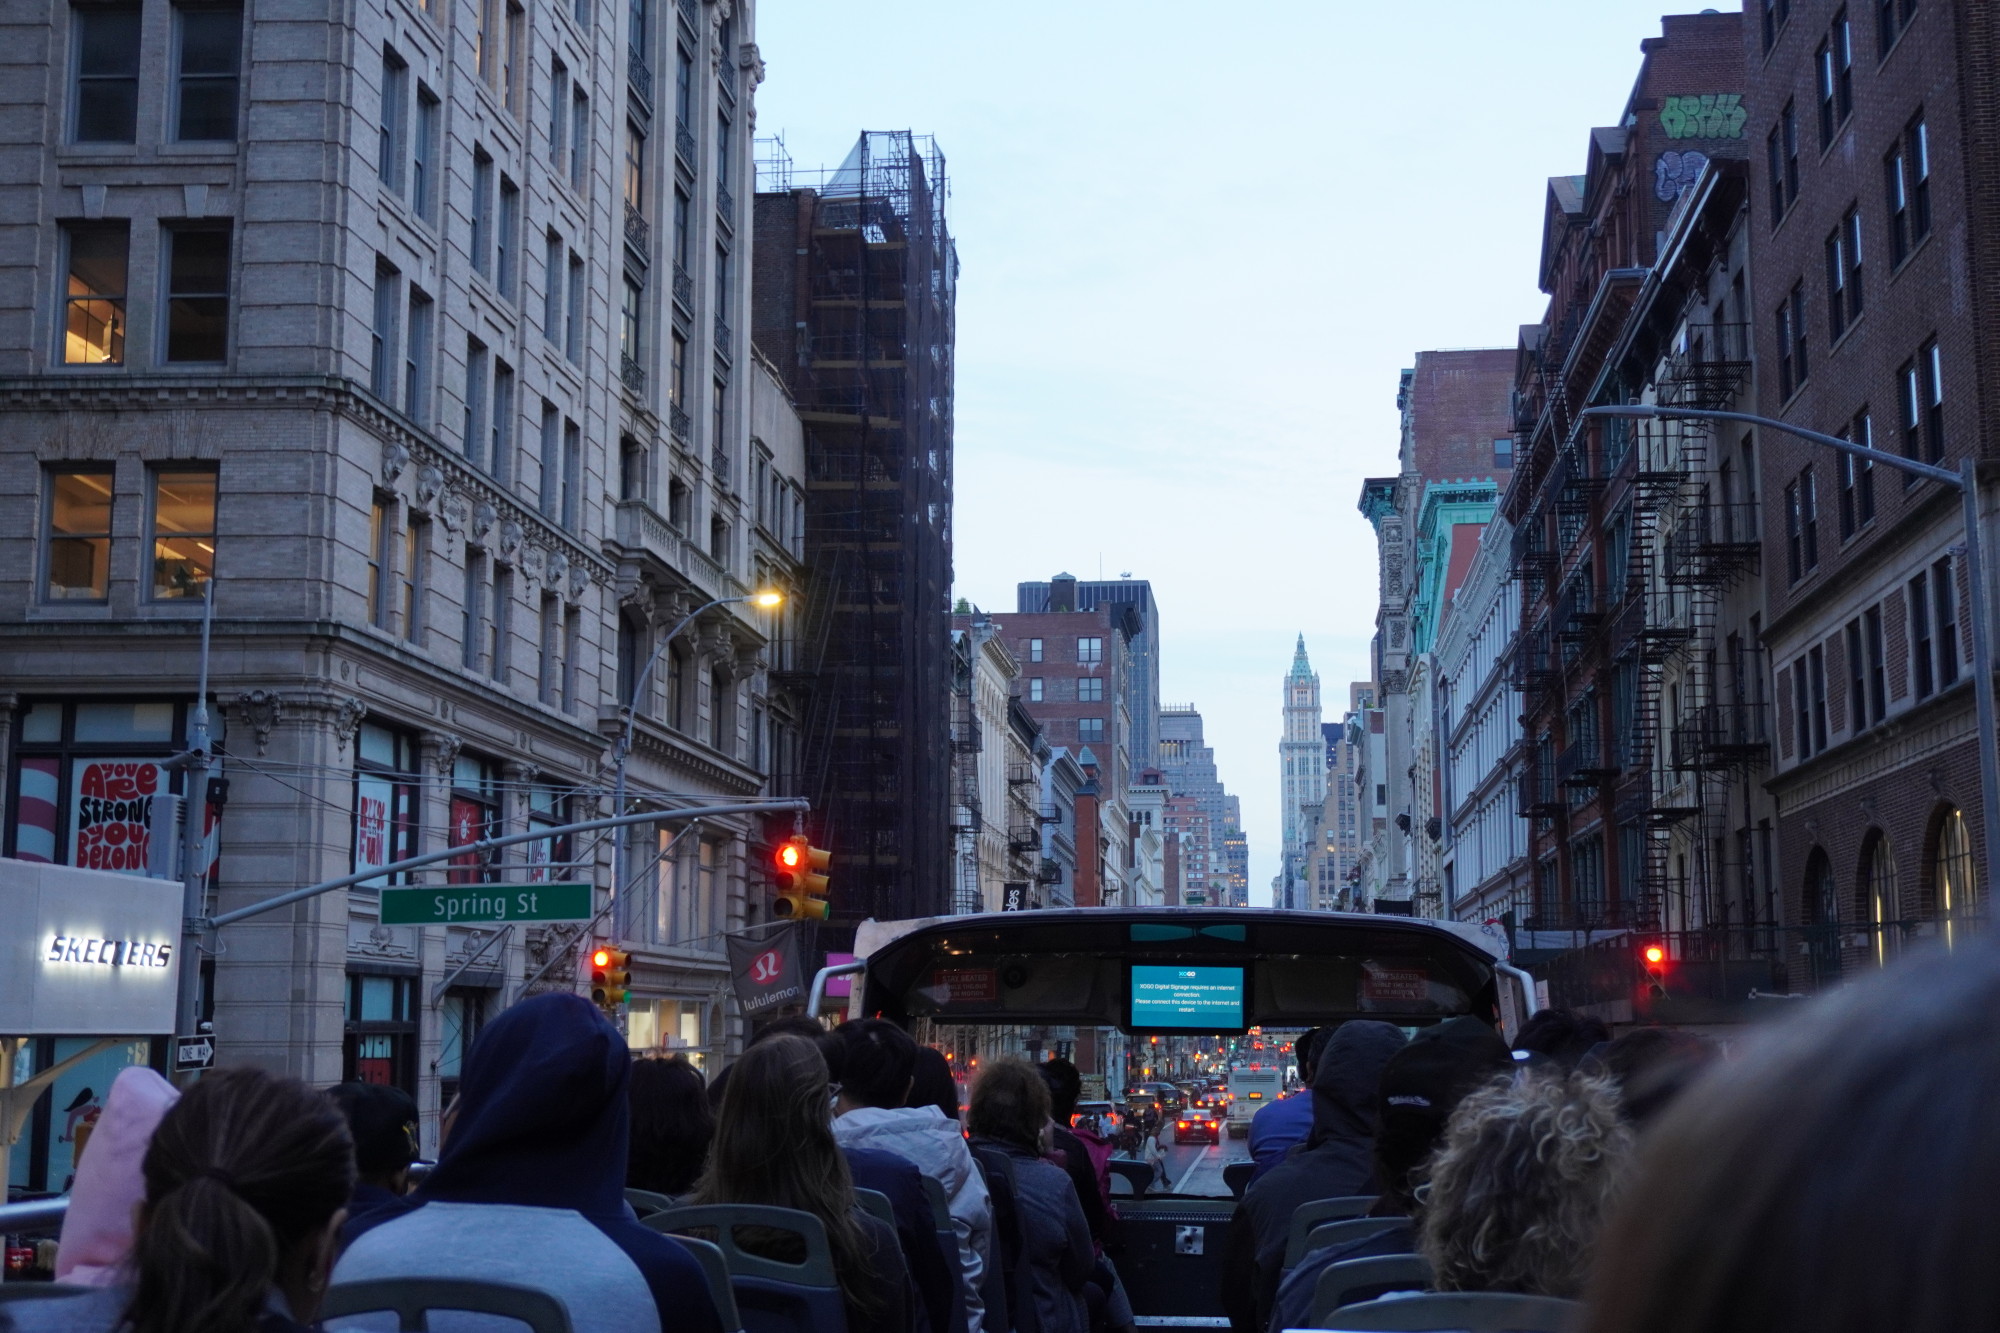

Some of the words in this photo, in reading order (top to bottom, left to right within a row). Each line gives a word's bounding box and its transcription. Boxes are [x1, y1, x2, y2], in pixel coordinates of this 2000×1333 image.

[433, 893, 506, 921] Spring
[517, 892, 538, 914] St
[48, 934, 172, 968] SKECHERS
[743, 985, 801, 1012] lululemon
[181, 1047, 192, 1060] ONE
[197, 1045, 210, 1059] WAY
